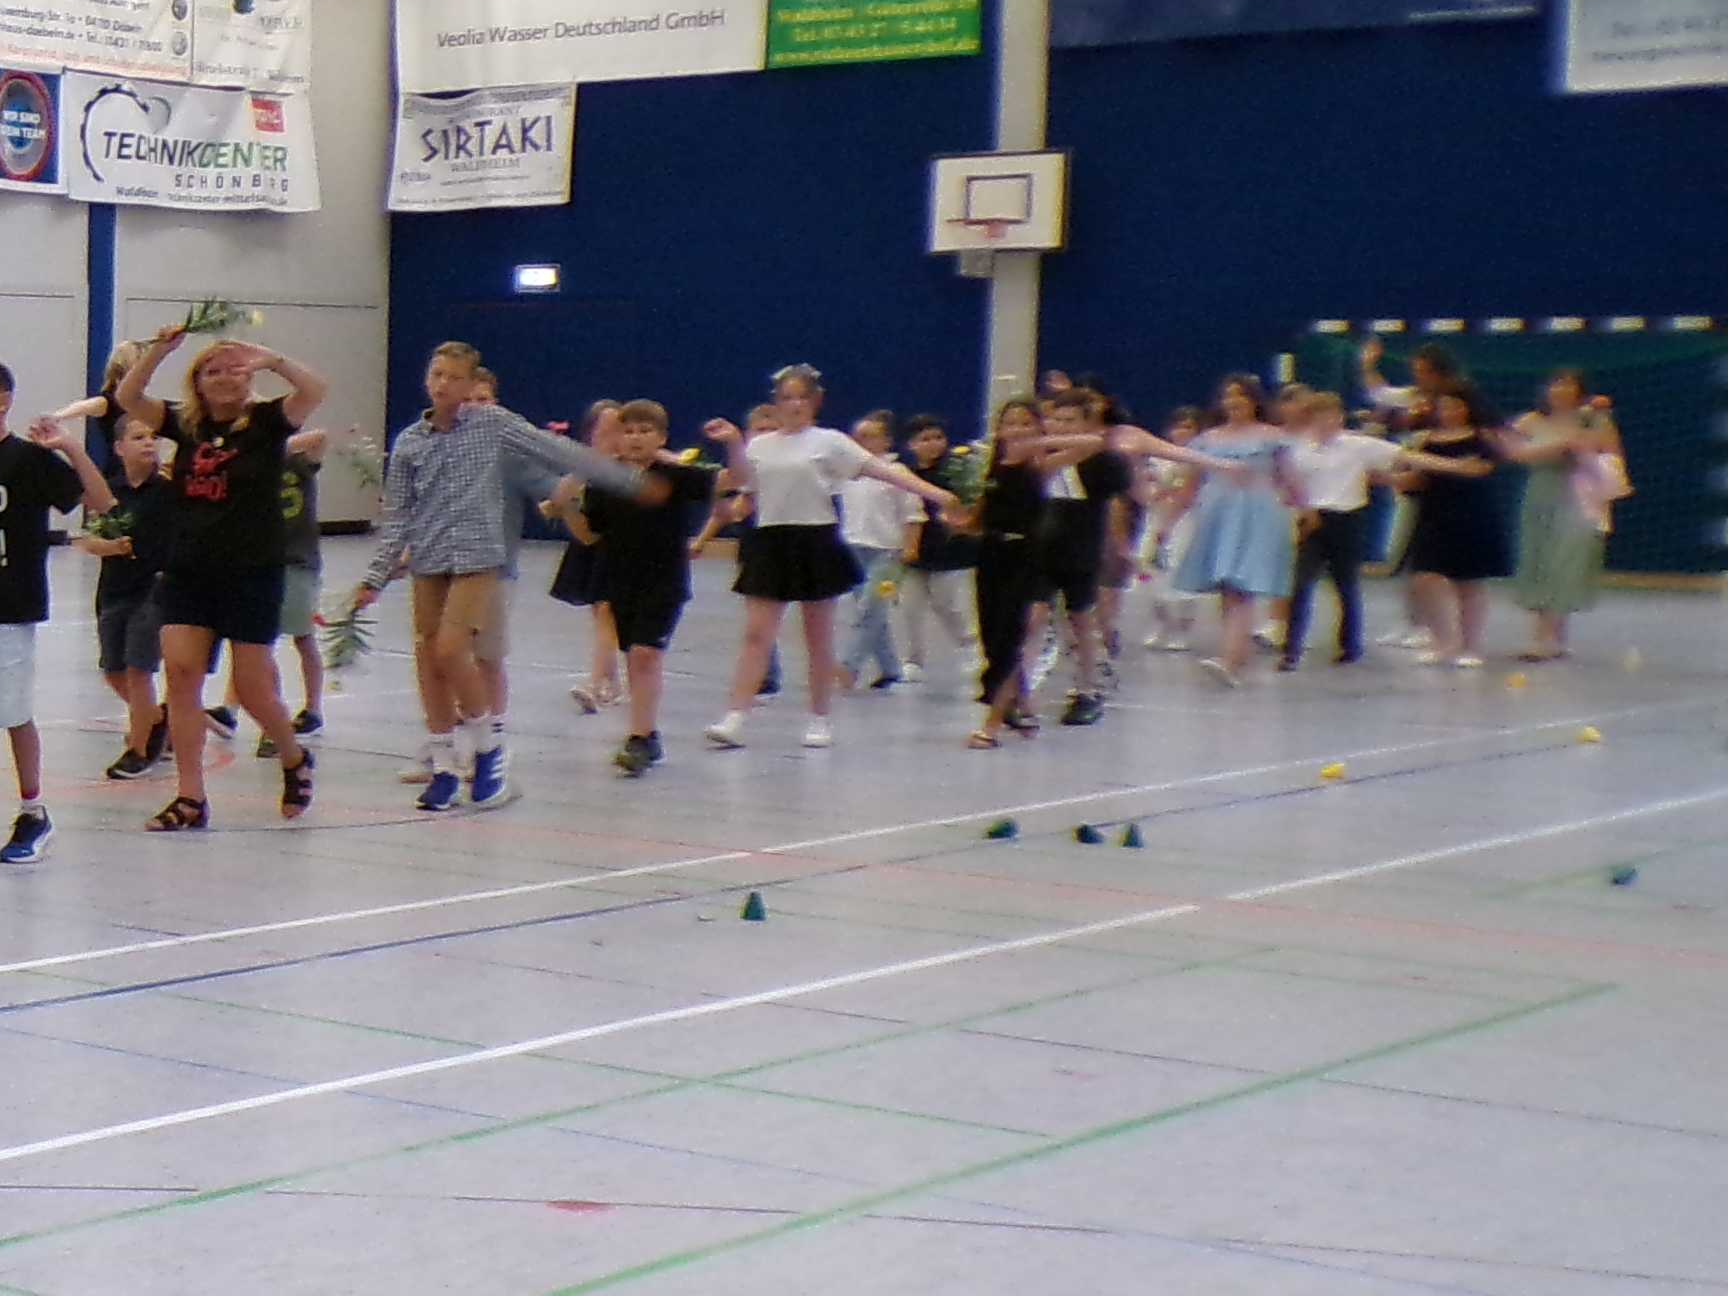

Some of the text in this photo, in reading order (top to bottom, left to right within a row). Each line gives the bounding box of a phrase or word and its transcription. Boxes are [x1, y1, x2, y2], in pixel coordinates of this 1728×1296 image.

[436, 9, 727, 48] Veolia Wasser Deutschland GmbH
[421, 114, 553, 162] SIRTAKI
